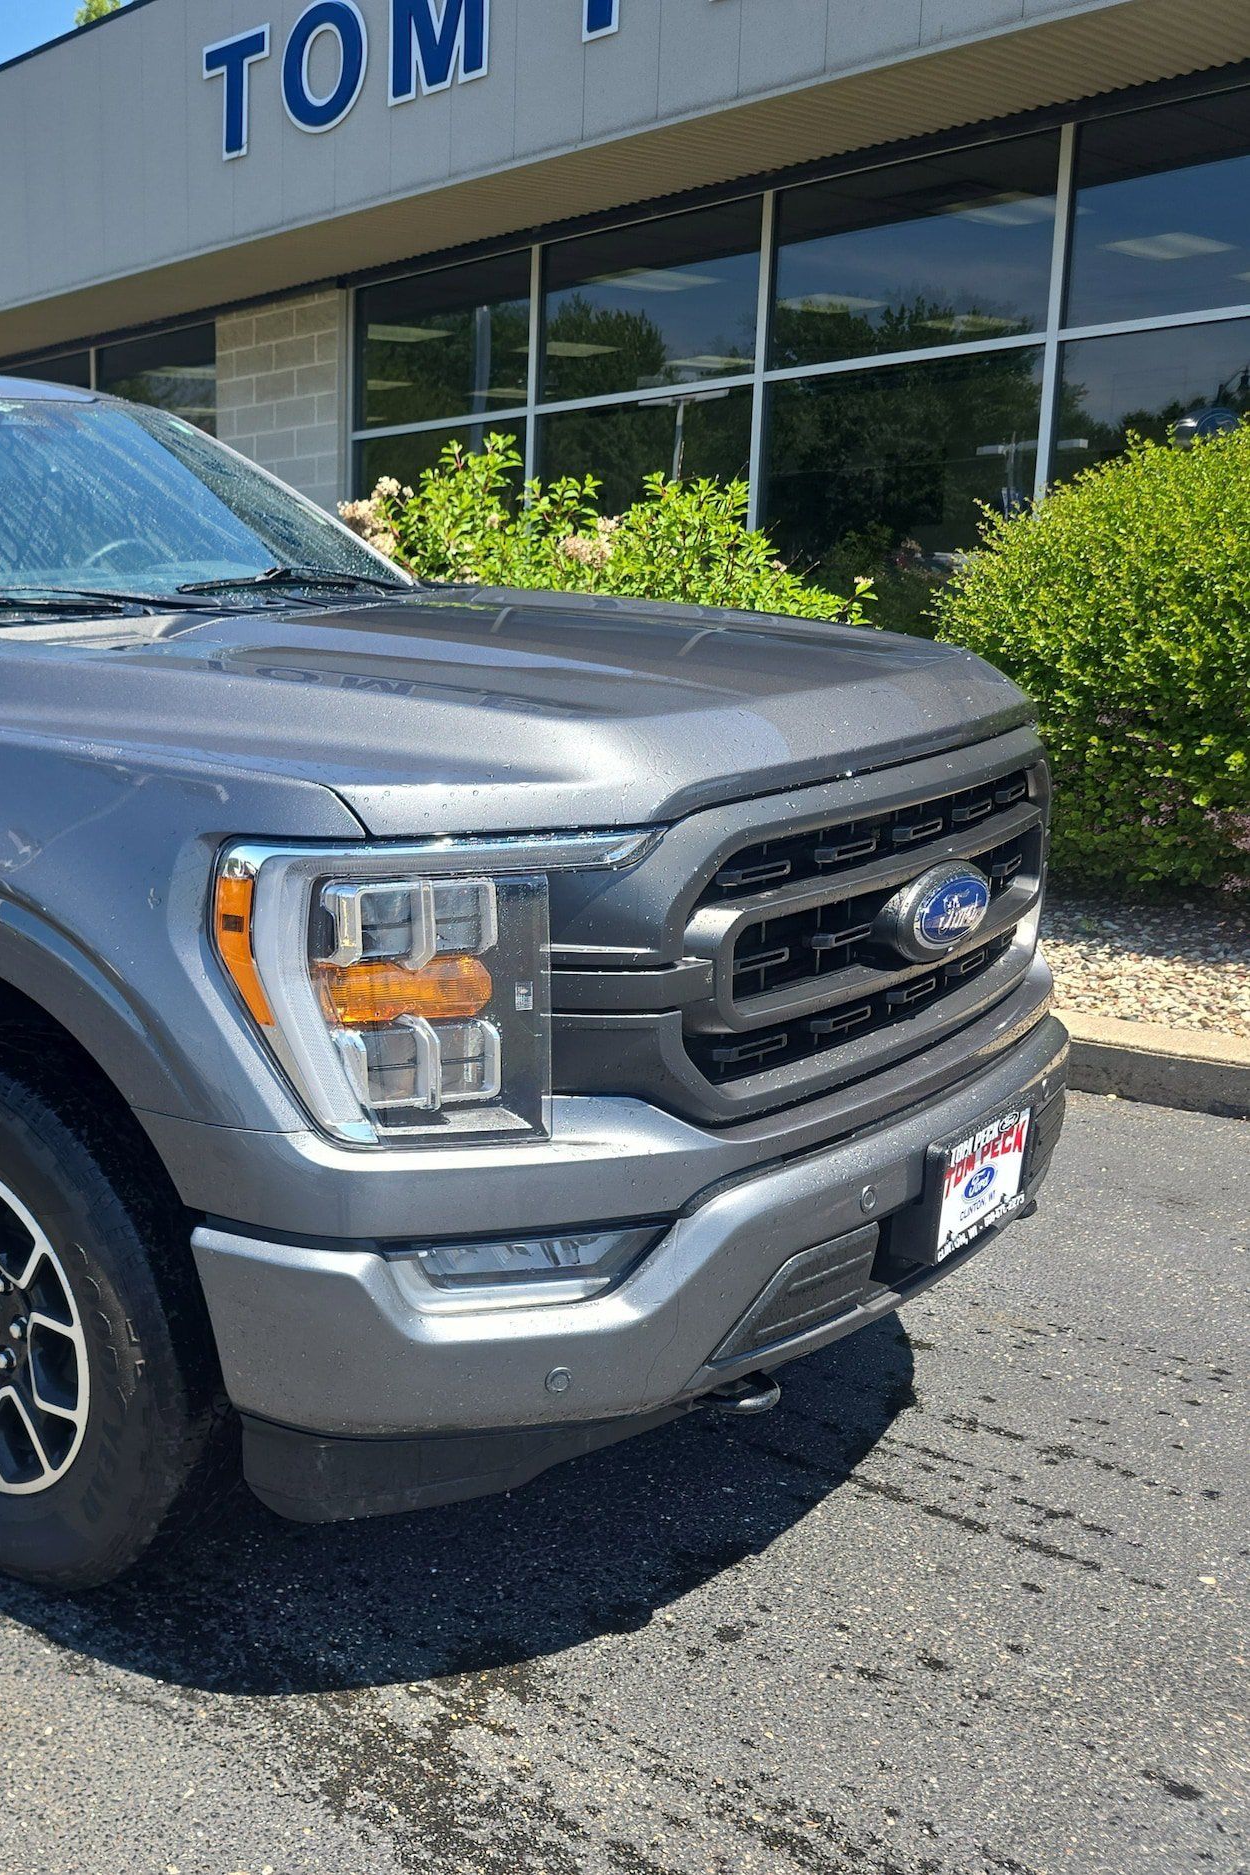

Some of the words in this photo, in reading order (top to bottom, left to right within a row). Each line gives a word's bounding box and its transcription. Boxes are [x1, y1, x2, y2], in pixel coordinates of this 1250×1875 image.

[202, 0, 490, 161] TOM
[937, 888, 981, 935] Ford
[944, 1154, 976, 1200] TOM
[980, 1119, 1026, 1165] PECK
[967, 1169, 993, 1199] Ford
